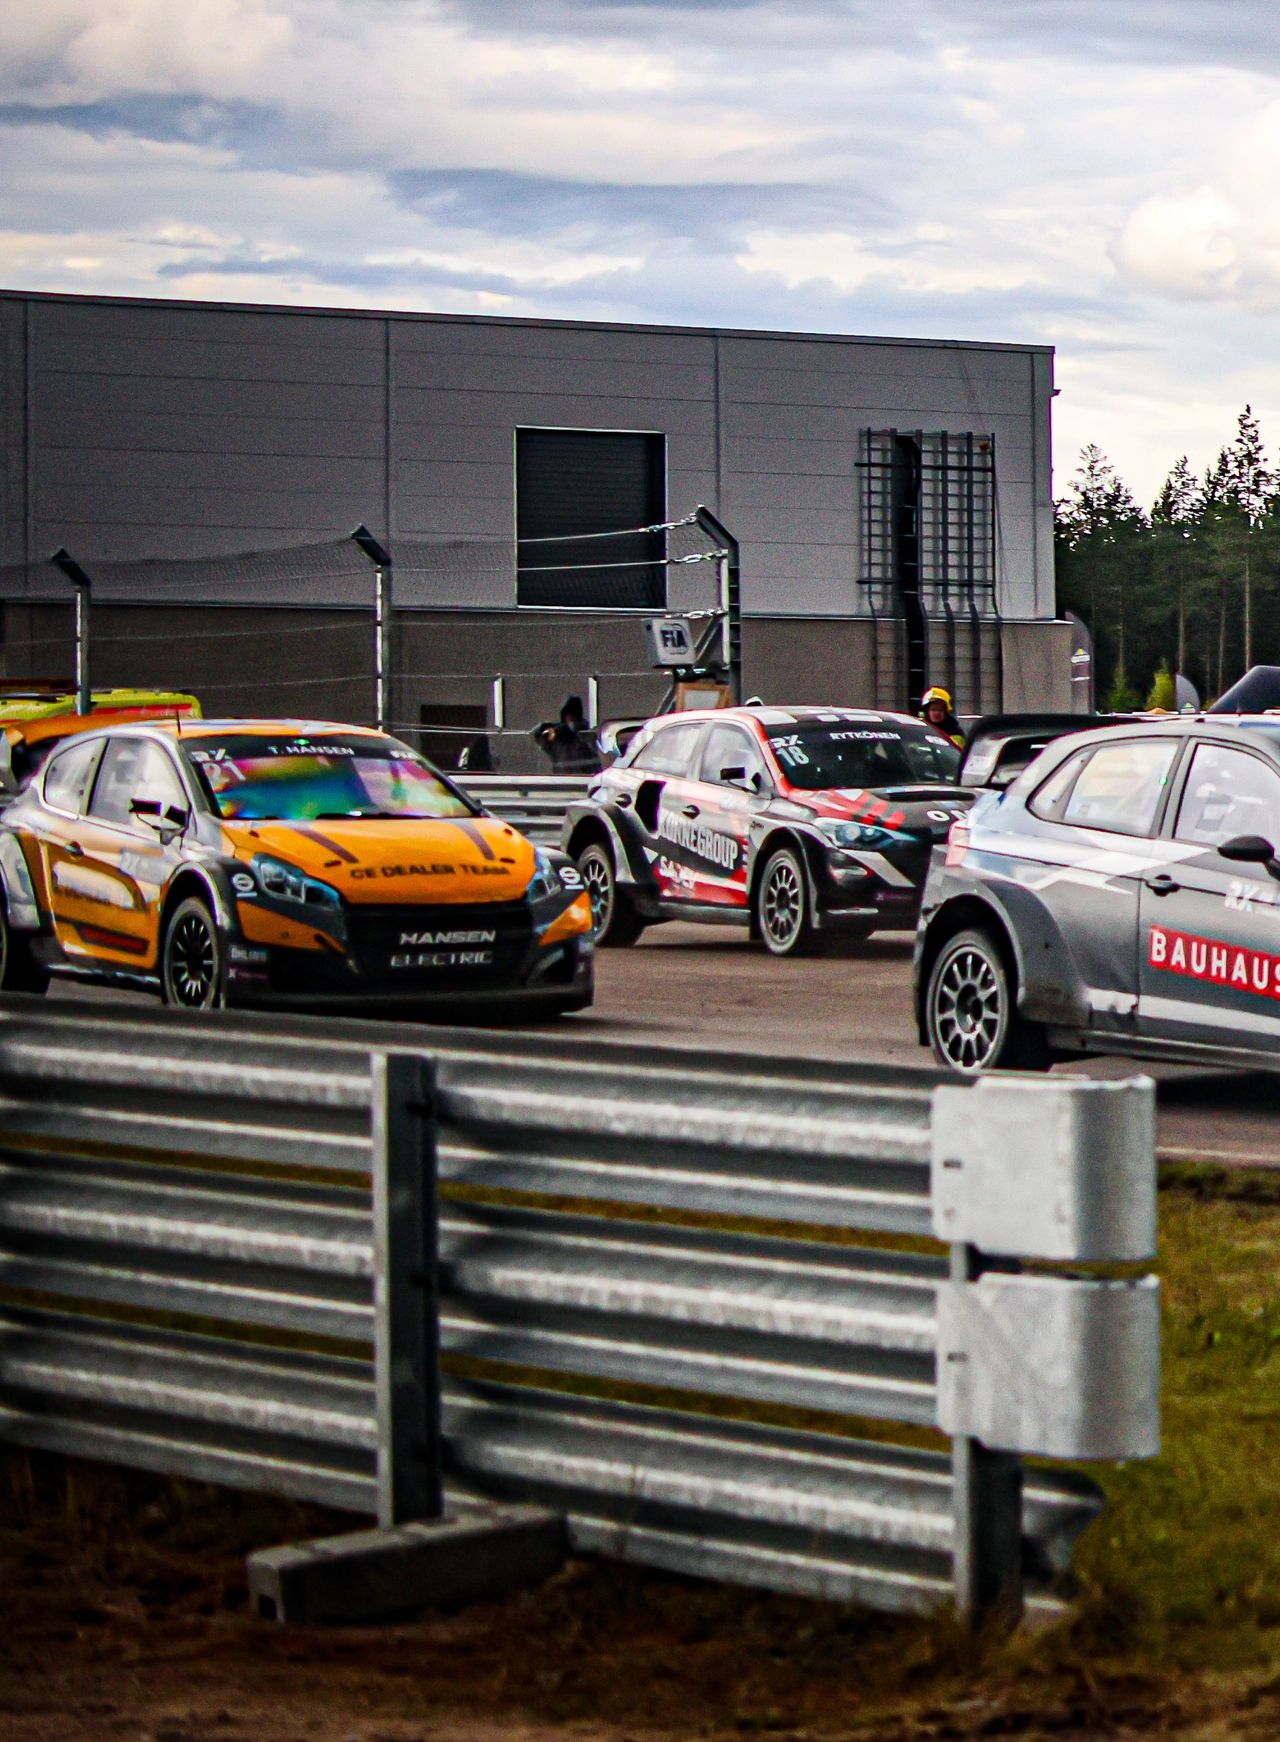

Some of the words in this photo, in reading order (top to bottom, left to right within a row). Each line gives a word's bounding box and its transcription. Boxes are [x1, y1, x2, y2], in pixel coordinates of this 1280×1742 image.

[660, 629, 688, 648] FIA
[829, 731, 902, 741] RYTKÖNEN
[268, 746, 284, 755] T.
[286, 746, 356, 757] HANSEN
[776, 746, 810, 767] 18
[203, 760, 247, 785] 21
[350, 867, 377, 880] CE
[381, 863, 456, 877] DEALER
[458, 863, 511, 877] TEAM
[399, 930, 497, 947] HANSEN
[389, 951, 494, 968] ELECTRIC
